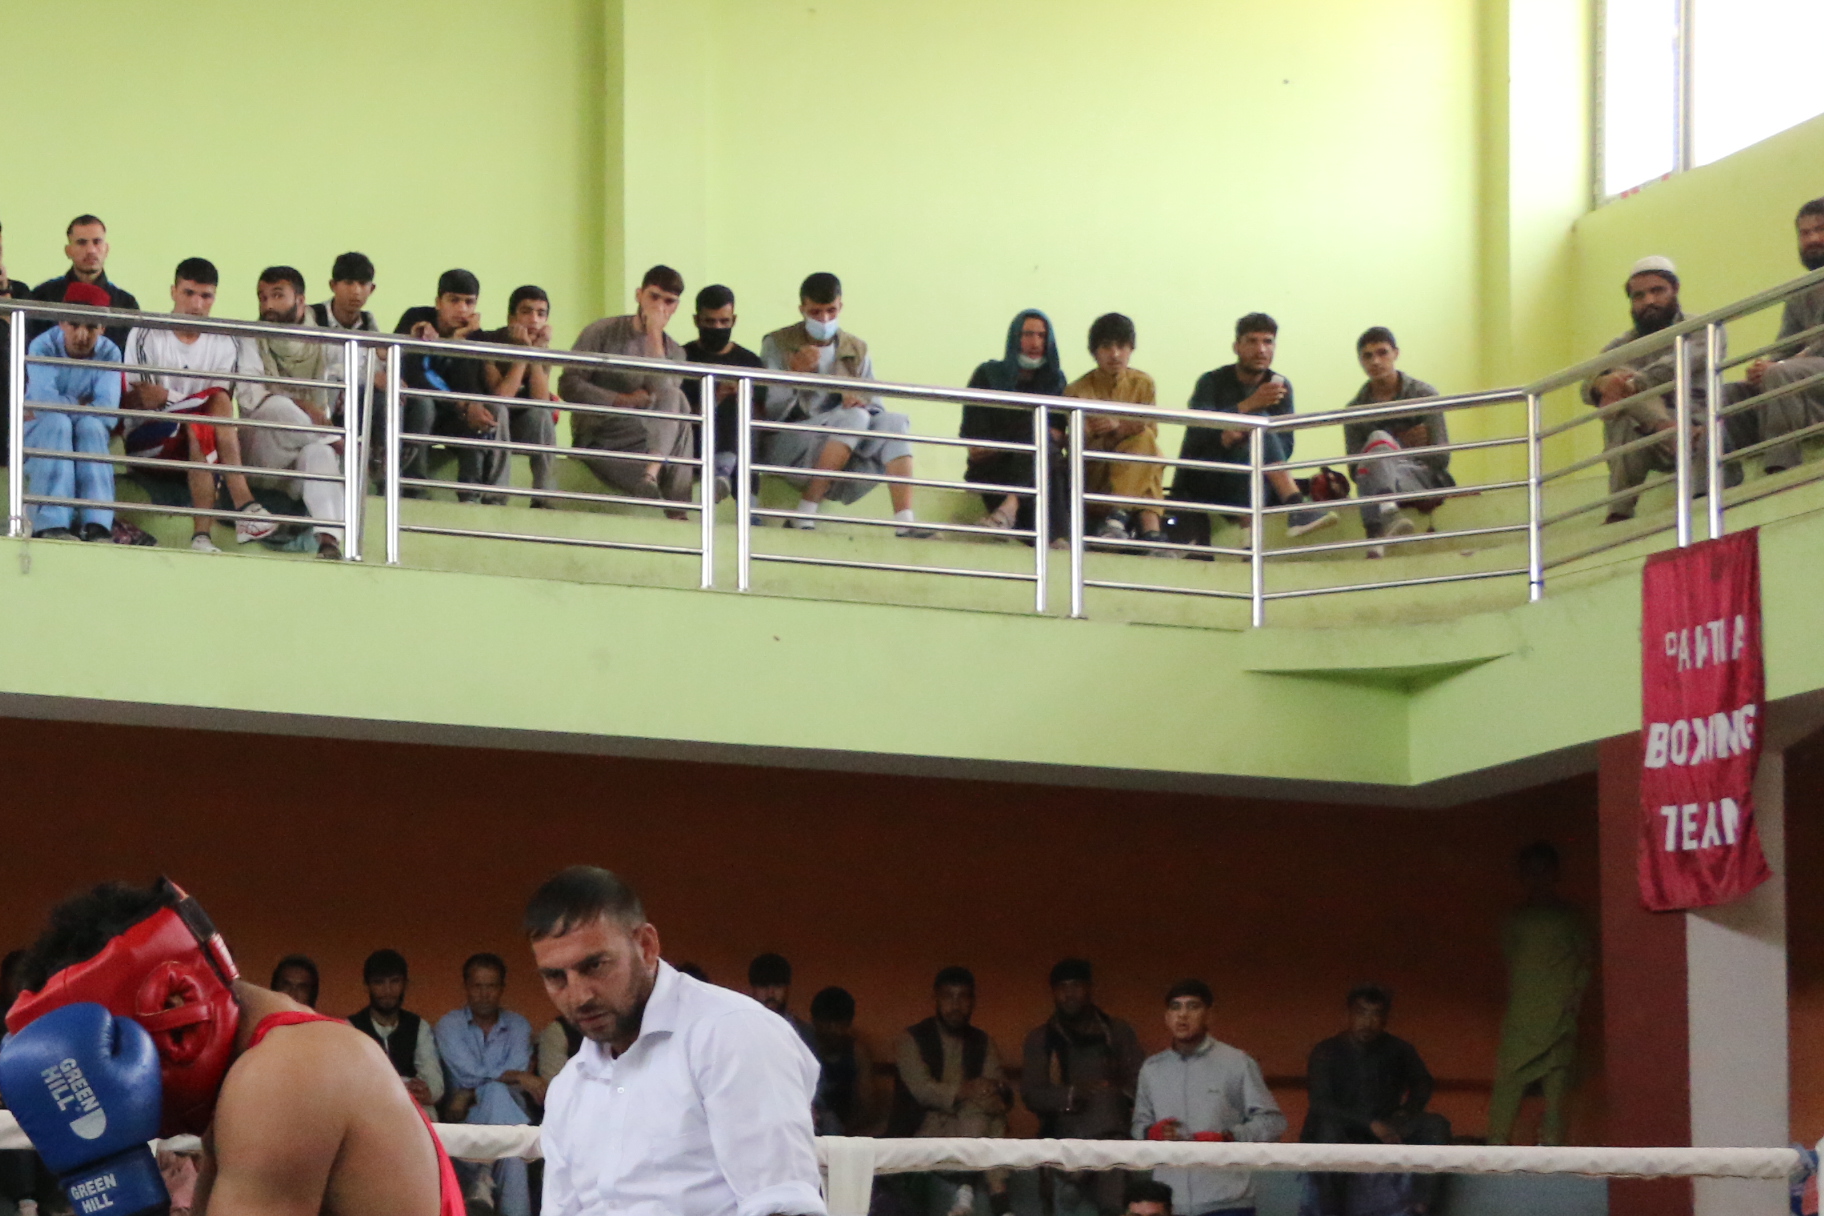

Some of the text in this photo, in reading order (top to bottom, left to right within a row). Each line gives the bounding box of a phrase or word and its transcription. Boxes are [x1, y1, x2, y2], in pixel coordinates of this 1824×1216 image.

[41, 1065, 75, 1112] HILL
[60, 1057, 100, 1112] GREEN
[70, 1173, 117, 1200] GREEN
[81, 1193, 114, 1214] HILL
